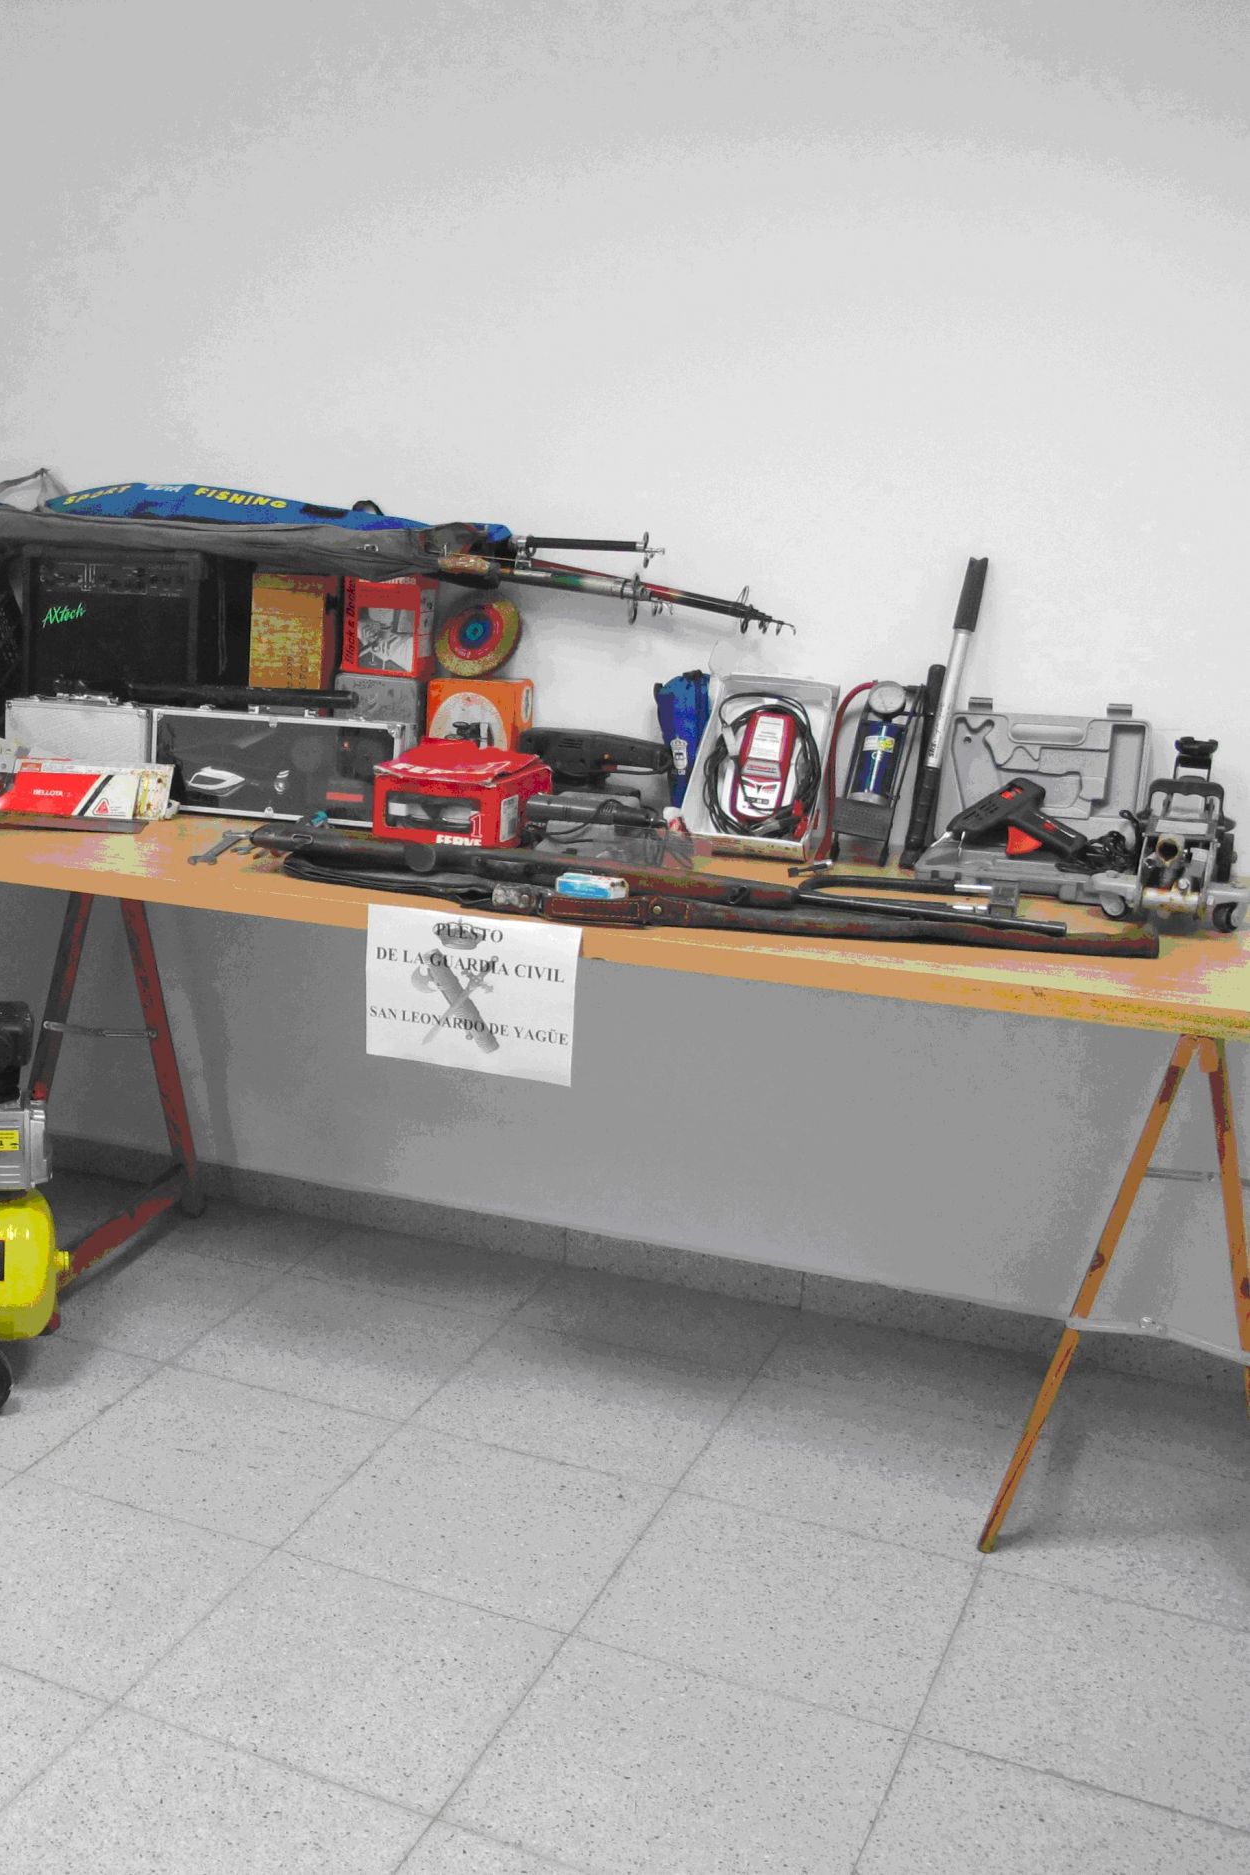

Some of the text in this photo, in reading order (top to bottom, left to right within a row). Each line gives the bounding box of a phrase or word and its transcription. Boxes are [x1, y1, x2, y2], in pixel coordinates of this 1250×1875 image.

[62, 485, 132, 505] SPORT
[193, 487, 288, 508] FISHING
[42, 603, 86, 628] AXtech
[32, 789, 63, 797] BELLOTA
[436, 922, 503, 943] PUESTO
[376, 947, 565, 983] DE LA GUARDIA CIVIL
[369, 1005, 570, 1046] SAN LEONARDO DE YAGÜE
